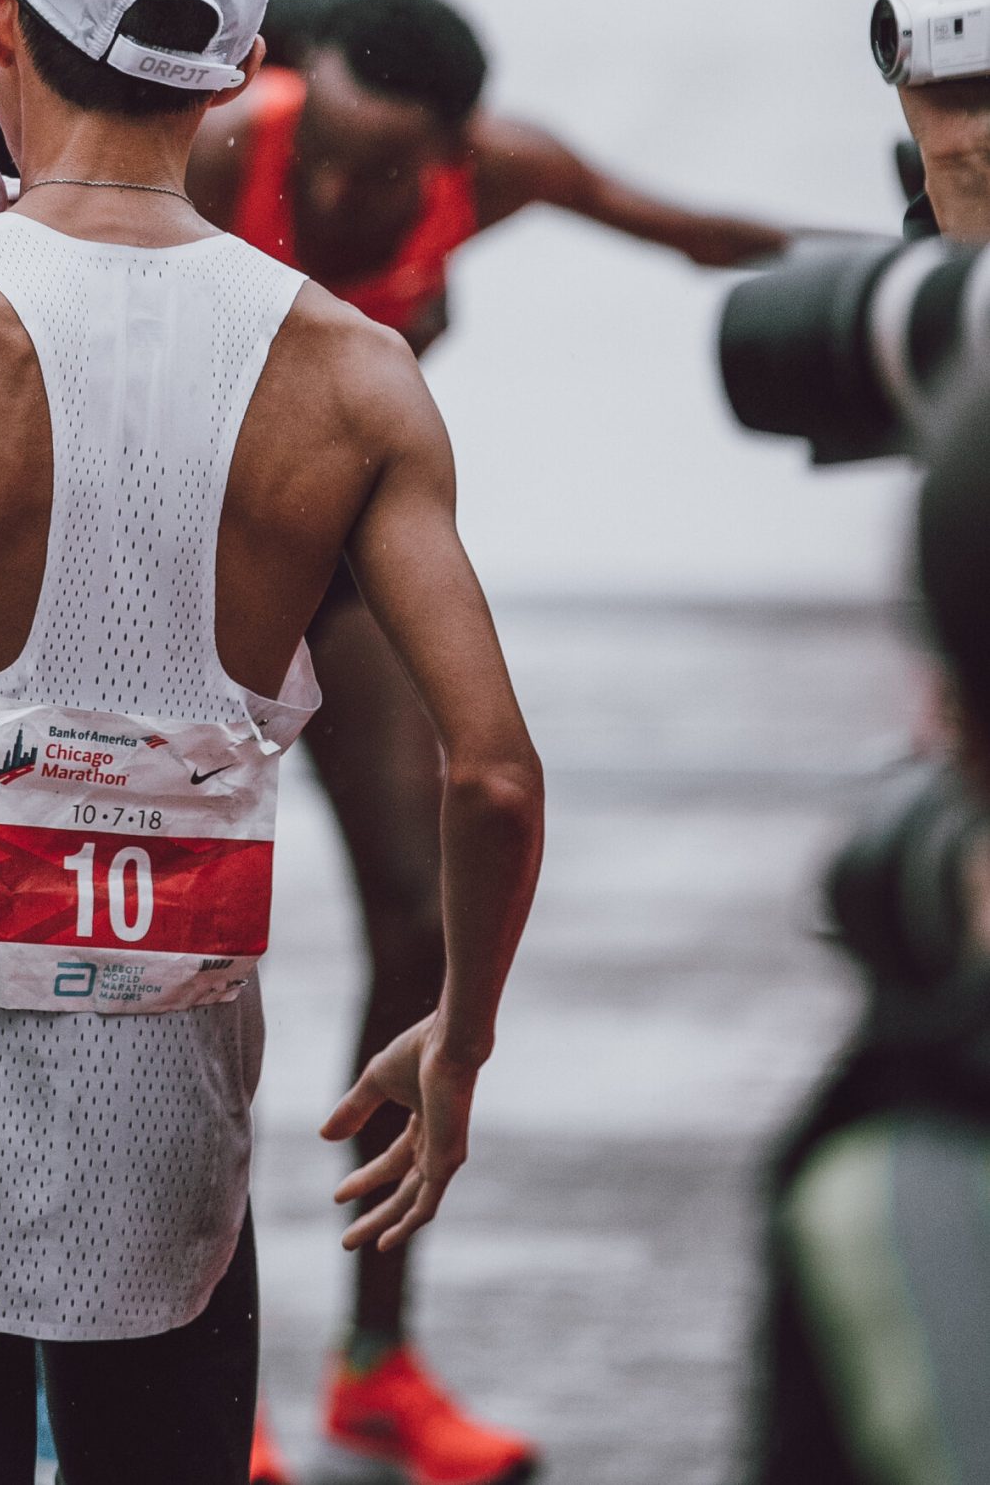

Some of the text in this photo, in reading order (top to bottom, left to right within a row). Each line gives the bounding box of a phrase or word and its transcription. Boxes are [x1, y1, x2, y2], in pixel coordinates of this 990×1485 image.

[139, 56, 210, 84] ORPJT
[90, 731, 138, 748] America
[45, 743, 114, 768] Chicago
[41, 762, 127, 787] Marathon
[63, 842, 154, 942] 10
[103, 963, 145, 975] ABBOTT
[102, 972, 141, 984] WORLD
[100, 982, 162, 994] MARATHON
[98, 992, 142, 1002] MAJORS
